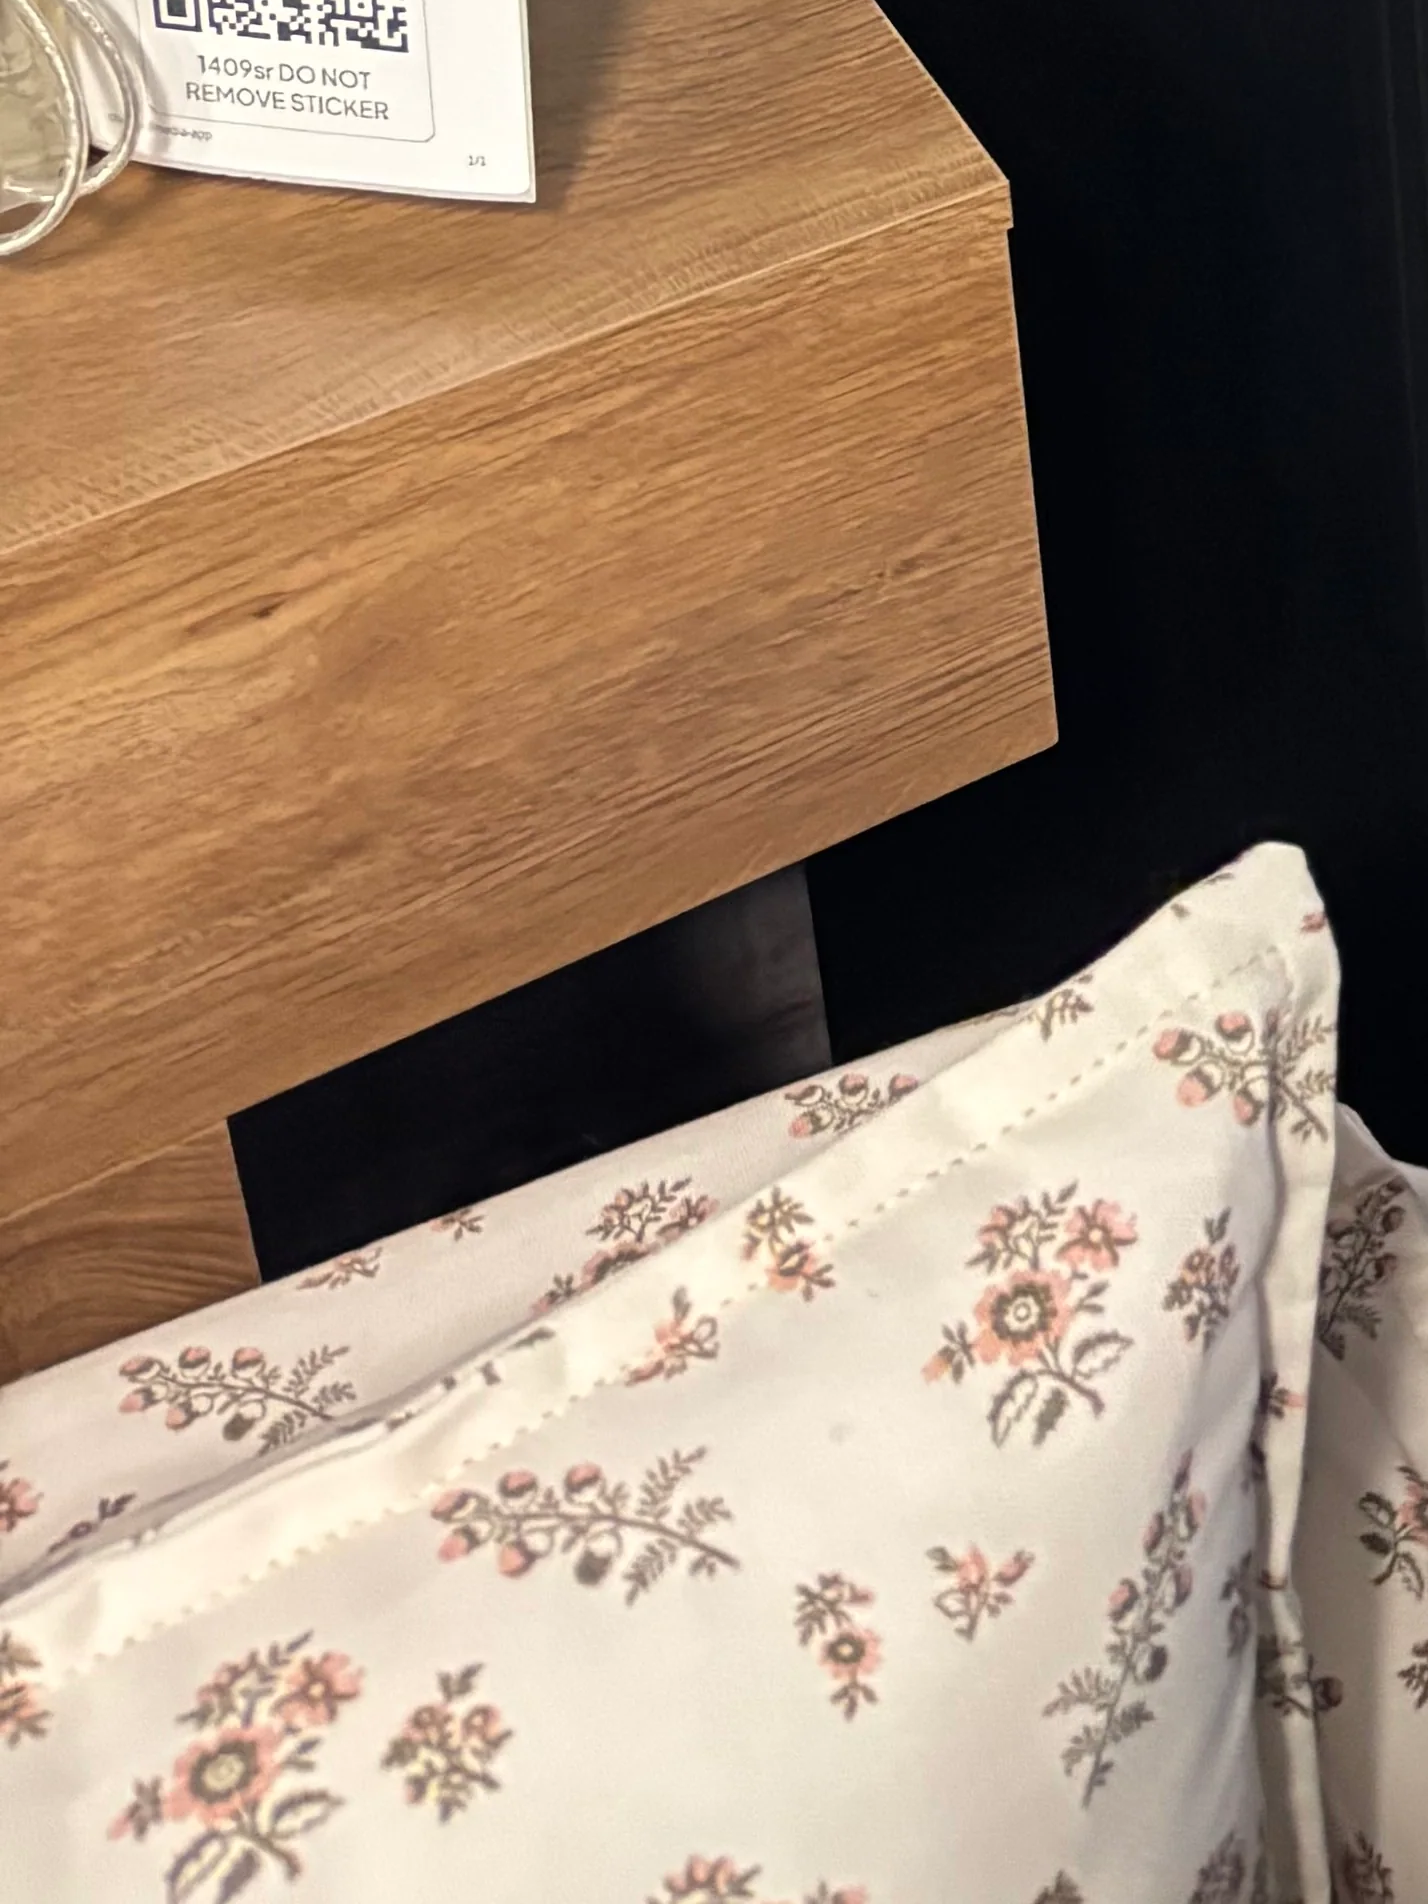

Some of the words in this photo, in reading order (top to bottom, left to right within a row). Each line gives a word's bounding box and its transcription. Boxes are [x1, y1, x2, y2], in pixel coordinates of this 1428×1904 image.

[197, 55, 274, 80] 1409sr
[279, 63, 316, 84] DO
[322, 68, 371, 90] NOT
[186, 82, 286, 110] REMOVE
[291, 93, 389, 120] STICKER
[468, 154, 487, 167] 1/1
